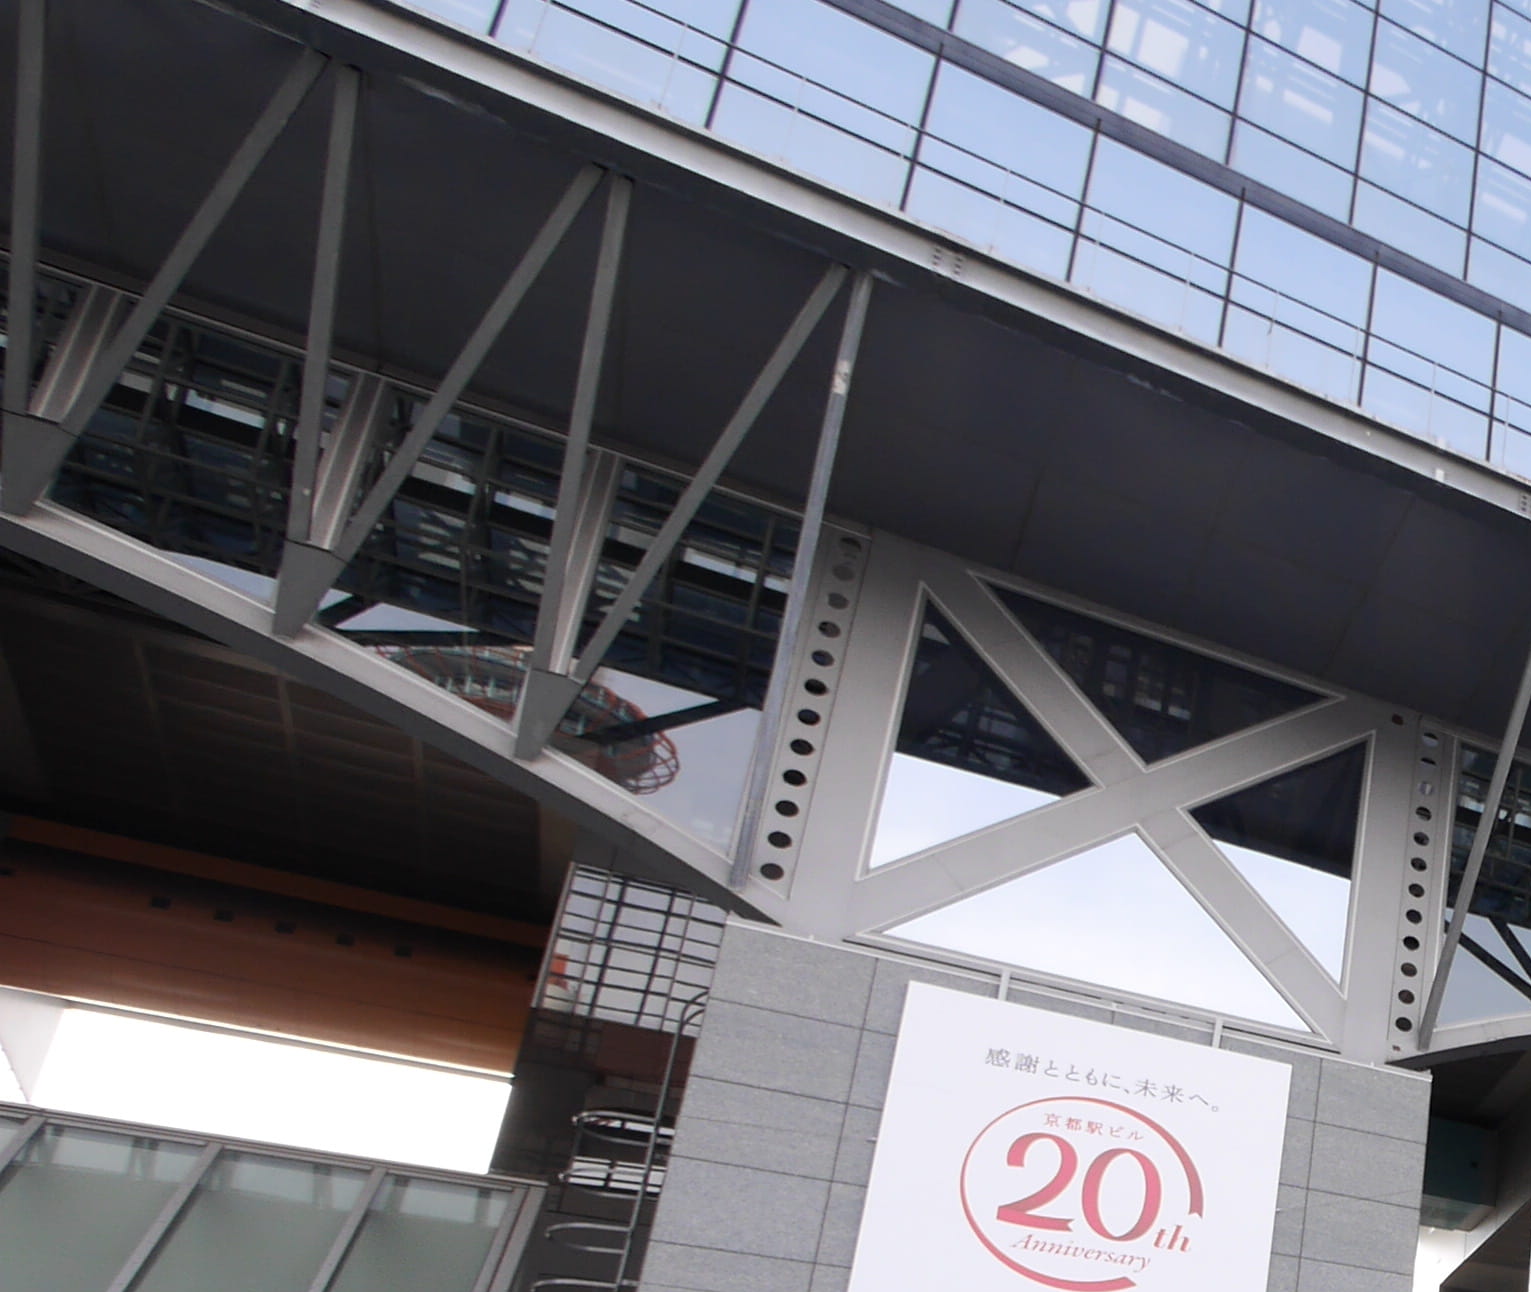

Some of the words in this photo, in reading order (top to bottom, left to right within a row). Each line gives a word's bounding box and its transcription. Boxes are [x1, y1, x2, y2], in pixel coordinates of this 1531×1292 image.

[984, 1046, 1221, 1114] 感謝とともに、未来へ。
[1042, 1112, 1145, 1142] 京都駅ビル
[1010, 1232, 1152, 1273] Anniversary
